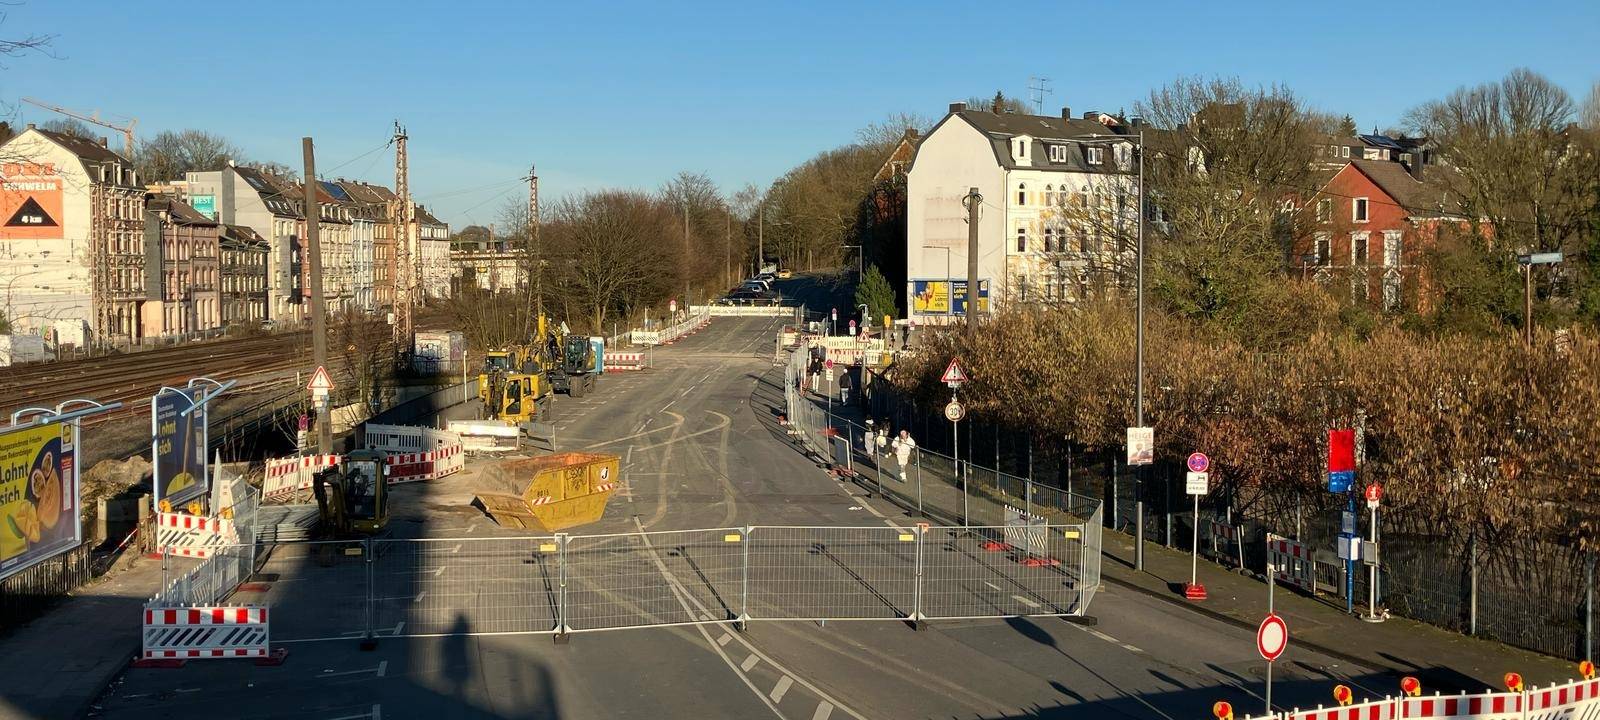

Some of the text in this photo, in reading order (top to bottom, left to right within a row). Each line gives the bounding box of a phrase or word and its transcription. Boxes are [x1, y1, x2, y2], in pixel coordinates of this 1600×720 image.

[3, 182, 57, 191] SCHWELM
[21, 215, 43, 223] 4 km
[159, 421, 176, 437] Lohnt
[159, 438, 171, 455] sich
[0, 461, 29, 484] Lohnt
[0, 485, 20, 506] sich
